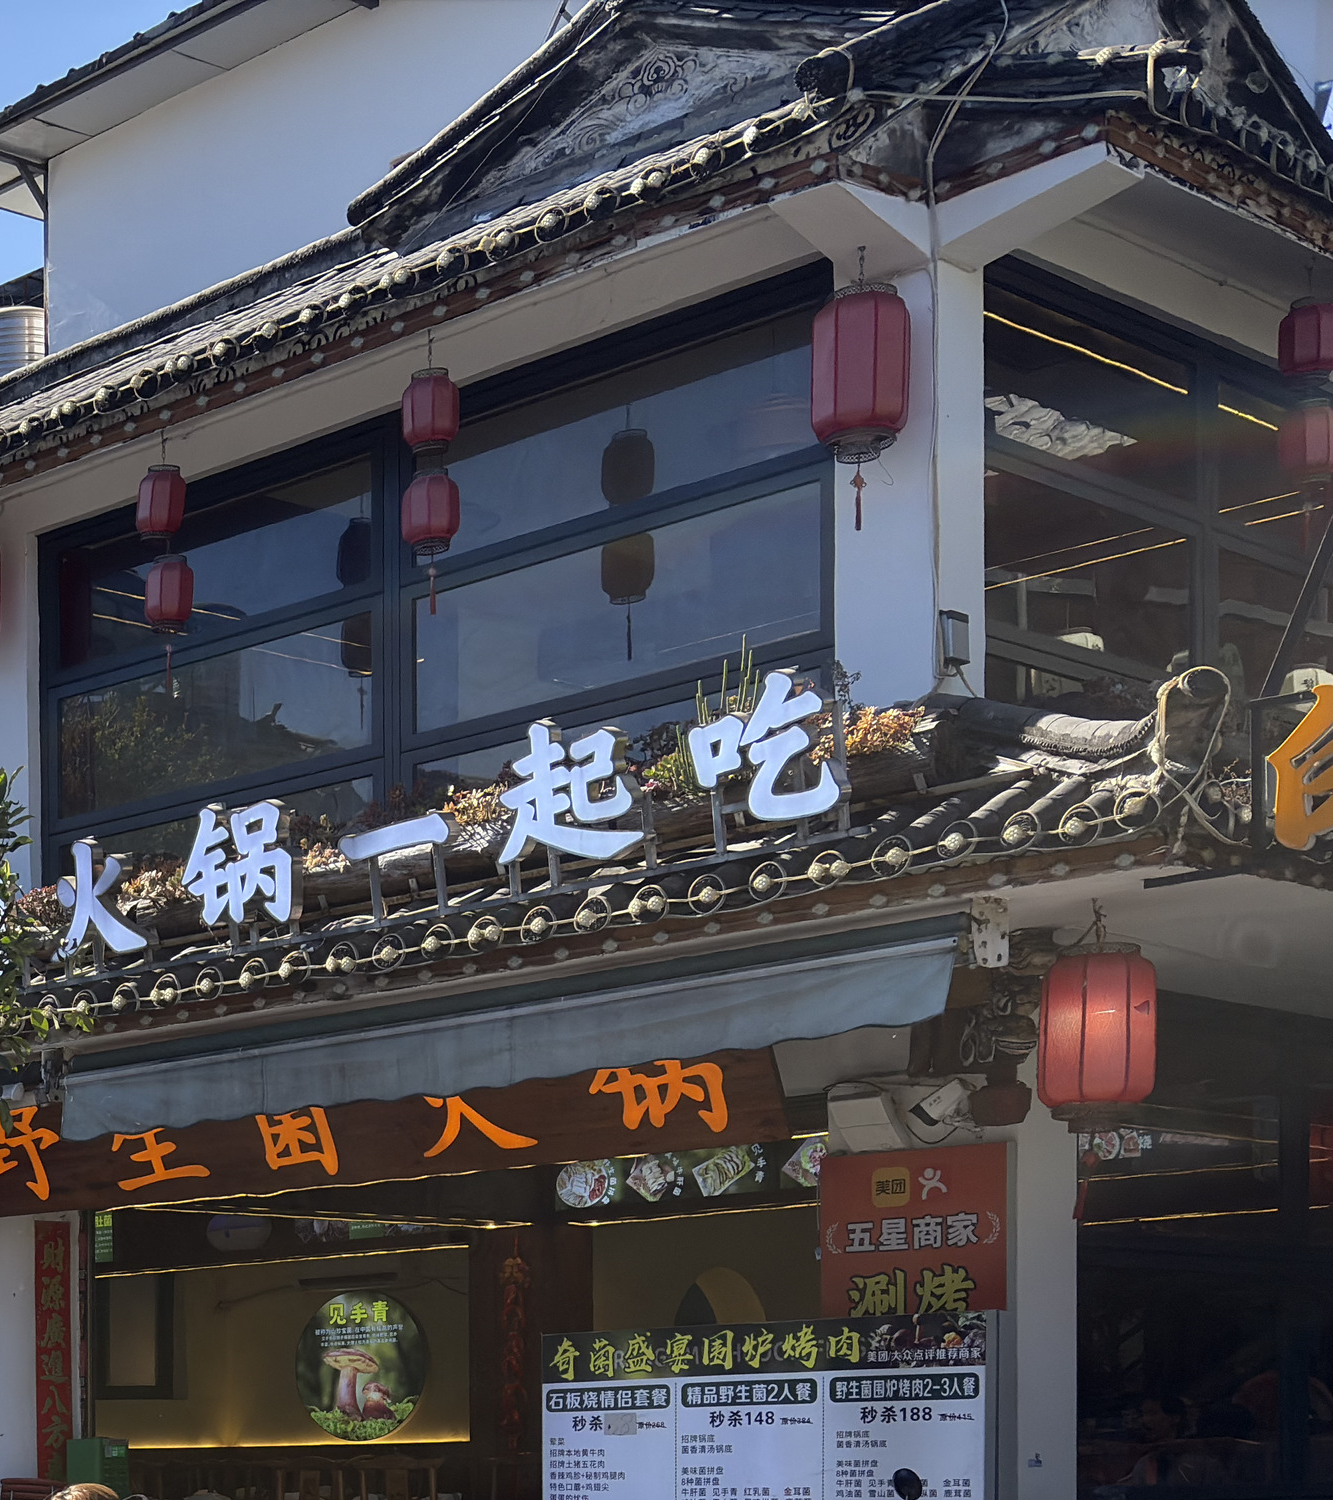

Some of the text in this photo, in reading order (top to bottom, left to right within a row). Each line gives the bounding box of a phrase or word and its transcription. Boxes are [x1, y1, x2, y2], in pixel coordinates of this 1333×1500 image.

[50, 669, 841, 956] 火锅一起吃
[875, 1179, 907, 1196] 美团
[845, 1211, 981, 1254] 五星商家
[847, 1262, 977, 1318] 涮烤
[329, 1300, 389, 1325] 见手青
[549, 1323, 861, 1381] 奇菌盛宴围炉烤肉
[866, 1346, 983, 1363] 美团/大众点评推荐商家
[686, 1382, 812, 1405] 精品野生菌2人餐
[835, 1377, 976, 1400] 野生菌围炉烤肉2-3人餐
[549, 1388, 668, 1410] 石板烧情侣套餐
[709, 1410, 775, 1428] 秒杀148
[860, 1405, 933, 1424] 秒杀188
[572, 1415, 604, 1432] 秒杀
[681, 1434, 716, 1444] 招牌锅底
[836, 1430, 870, 1438] 招牌锅底
[549, 1449, 605, 1458] 招牌本地黄牛肉
[549, 1460, 605, 1469] 招牌土猪五花肉
[681, 1466, 724, 1475] 美味菌拼盘
[836, 1460, 879, 1468] 美味菌拼盘
[681, 1477, 720, 1486] 8种菌拼盘
[835, 1469, 874, 1478] 8种菌拼盘
[681, 1487, 811, 1497] 牛肝菌 见手青 红乳菌 金耳菌
[835, 1479, 862, 1488] 牛肝菌
[943, 1479, 971, 1487] 金耳菌
[835, 1489, 862, 1498] 鸡油菌
